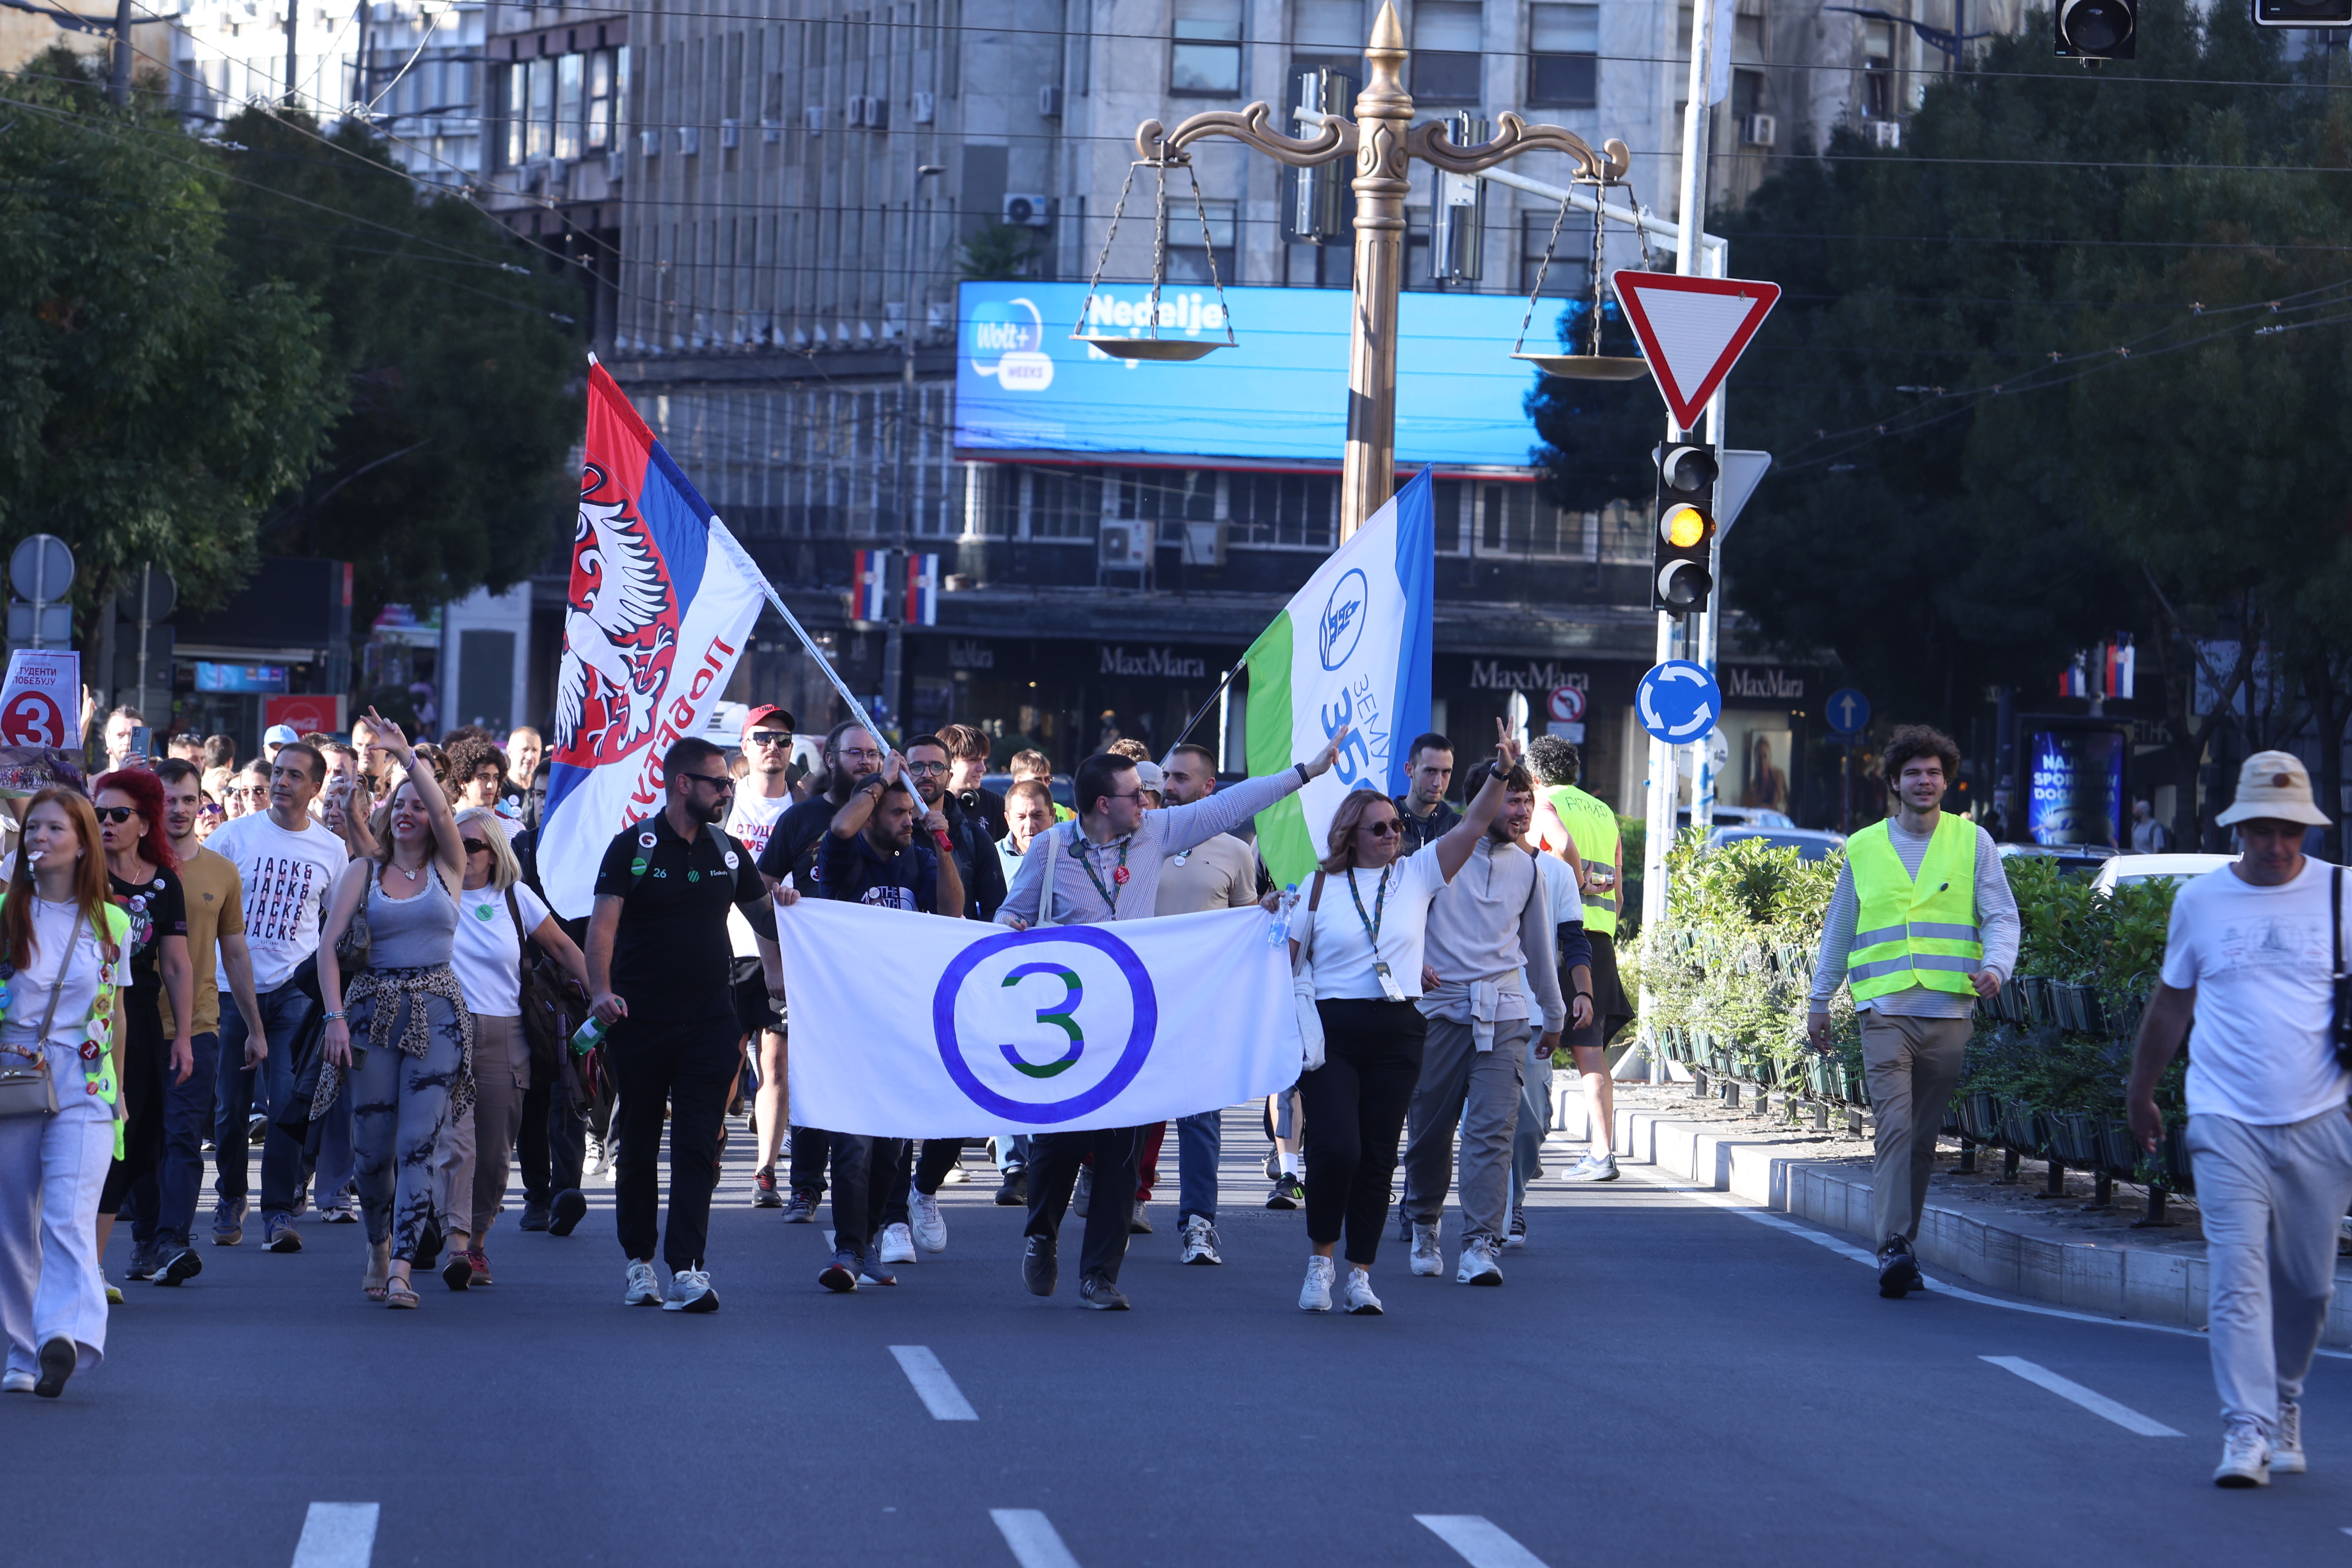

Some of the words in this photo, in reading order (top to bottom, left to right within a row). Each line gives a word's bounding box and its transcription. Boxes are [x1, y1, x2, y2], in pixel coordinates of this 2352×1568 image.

[1089, 293, 1224, 337] Nedelje
[1101, 647, 1206, 678] MaxMara
[15, 667, 56, 676] СТУДЕНТИ
[12, 676, 56, 686] ПОБЕЂУЈУ
[653, 868, 667, 878] 26
[877, 886, 898, 898] THE
[999, 962, 1084, 1078] 3
